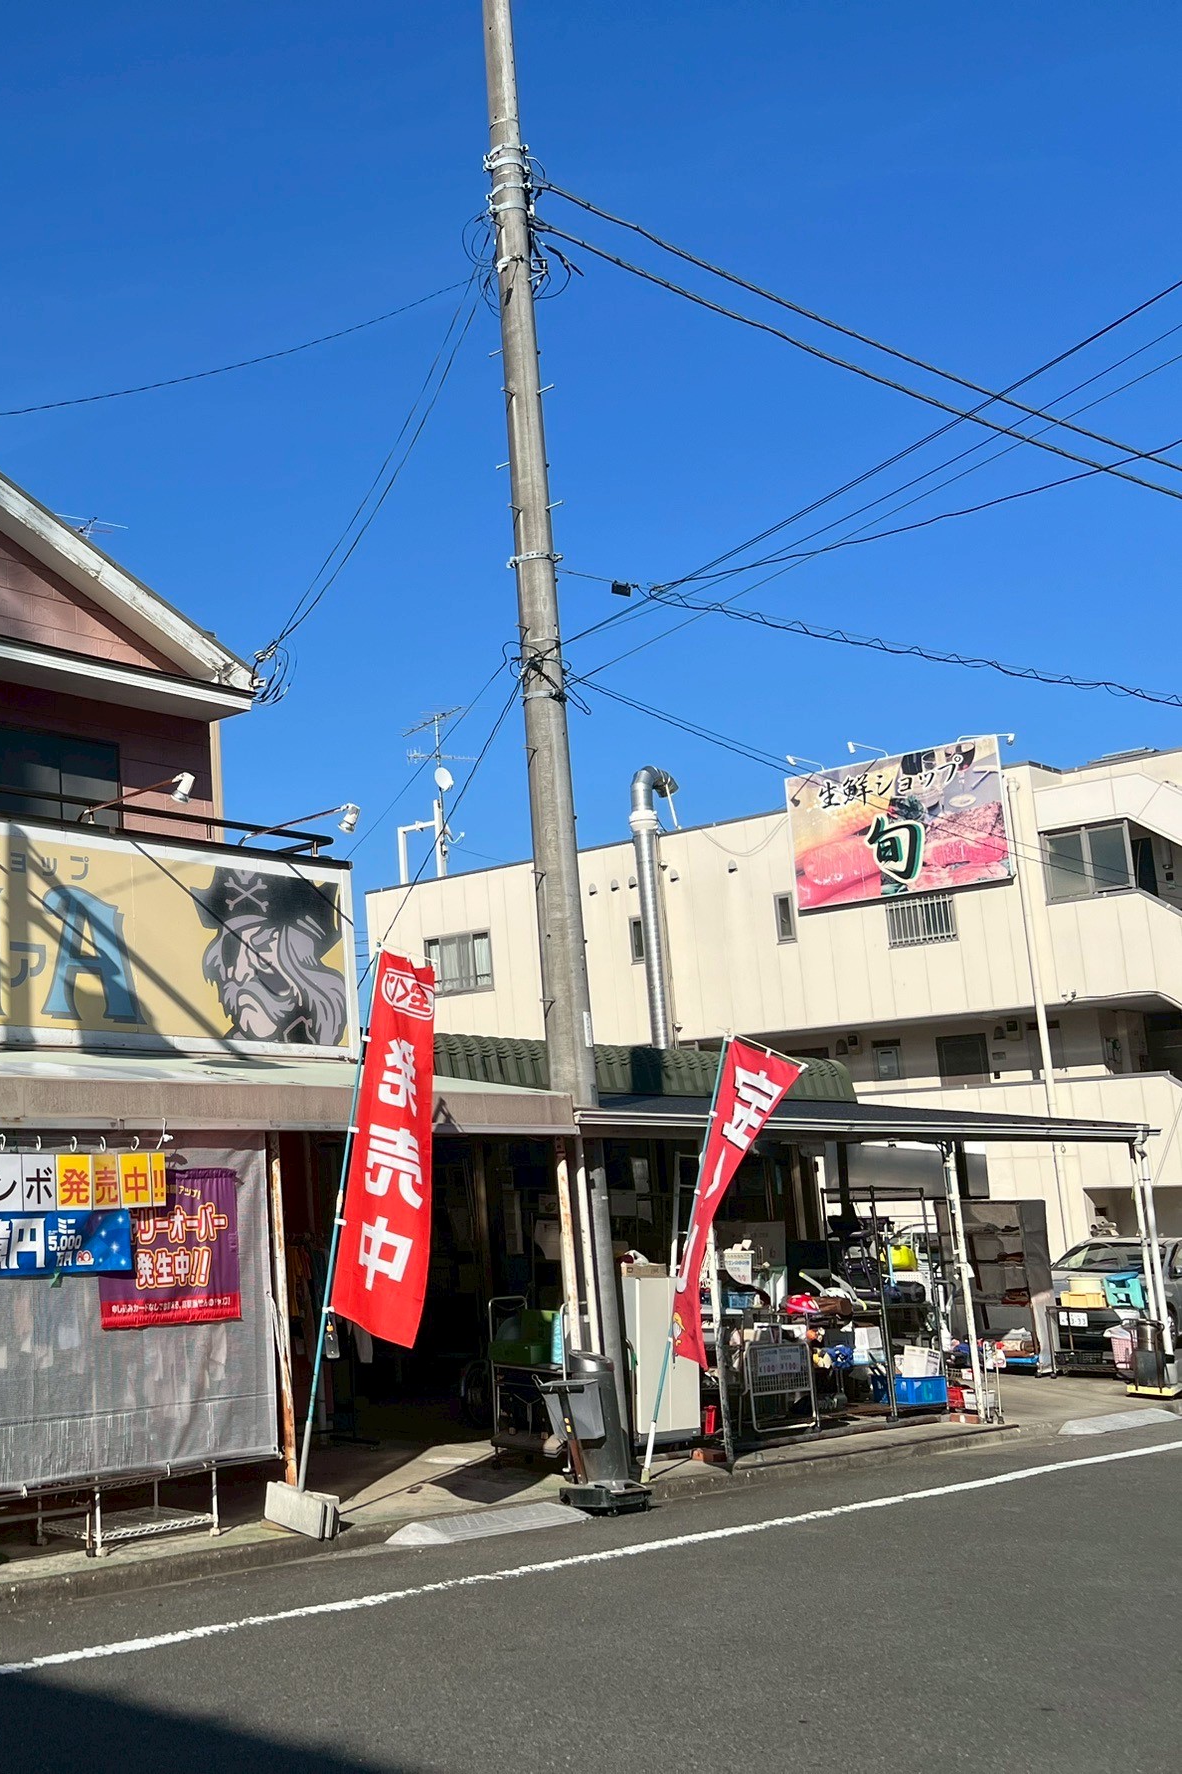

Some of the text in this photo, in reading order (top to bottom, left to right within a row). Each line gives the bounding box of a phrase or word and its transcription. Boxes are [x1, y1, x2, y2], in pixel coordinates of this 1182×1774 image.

[818, 755, 963, 809] 生鮮ショップ
[868, 816, 923, 881] 旬
[48, 1234, 82, 1251] 5,000
[58, 1217, 76, 1235] ミニ
